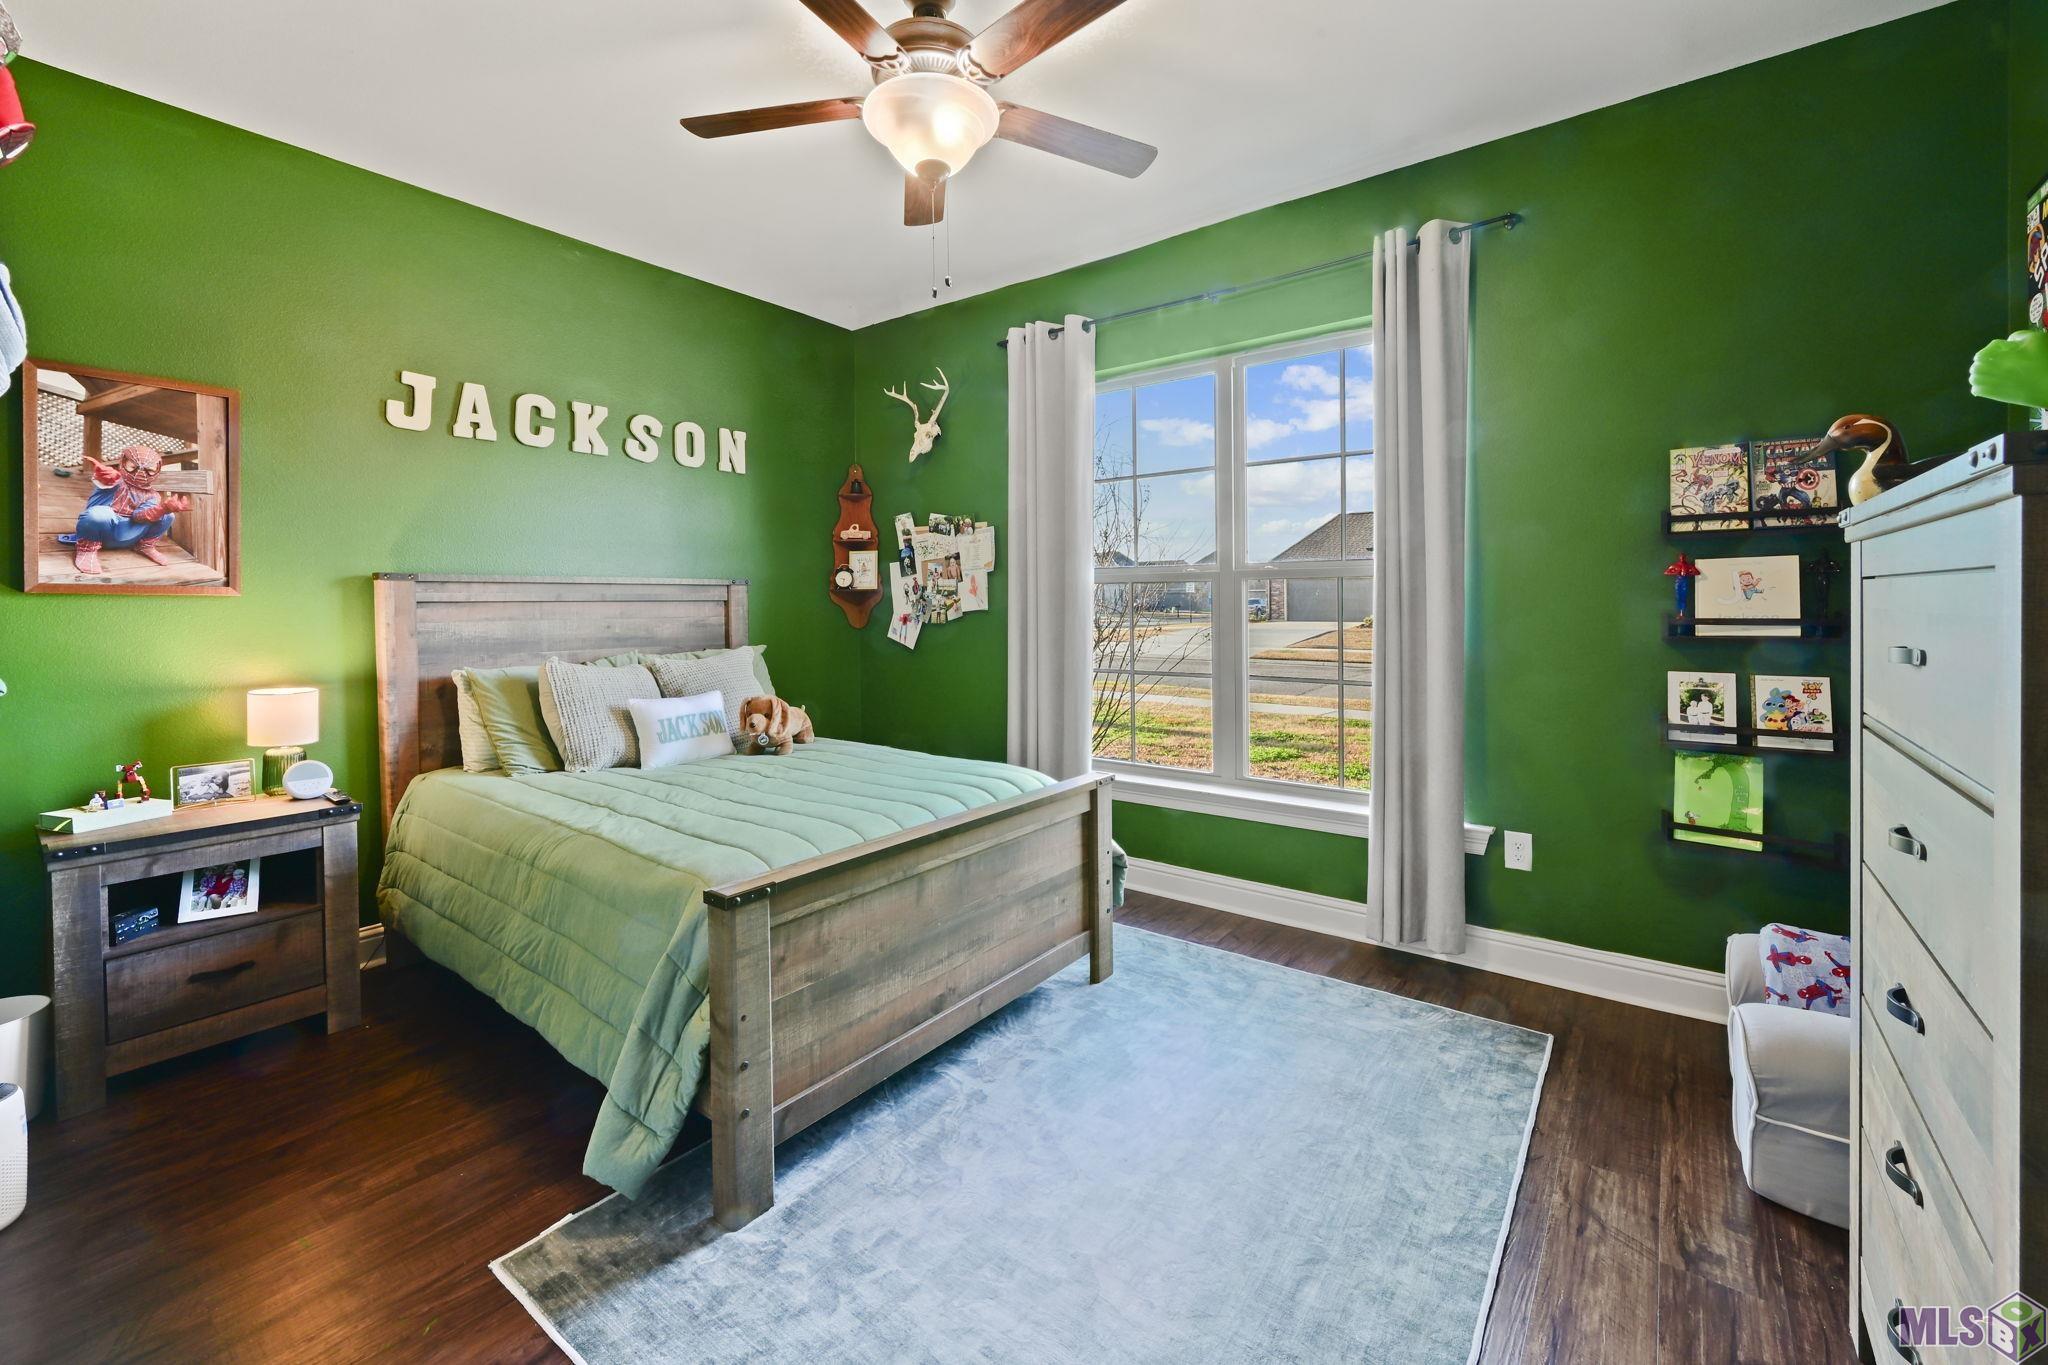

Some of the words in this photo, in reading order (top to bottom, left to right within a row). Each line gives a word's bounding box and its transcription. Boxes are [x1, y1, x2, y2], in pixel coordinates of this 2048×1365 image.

[384, 370, 747, 474] JACKSON
[1689, 450, 1743, 468] VENOM
[656, 710, 727, 744] JACKSON
